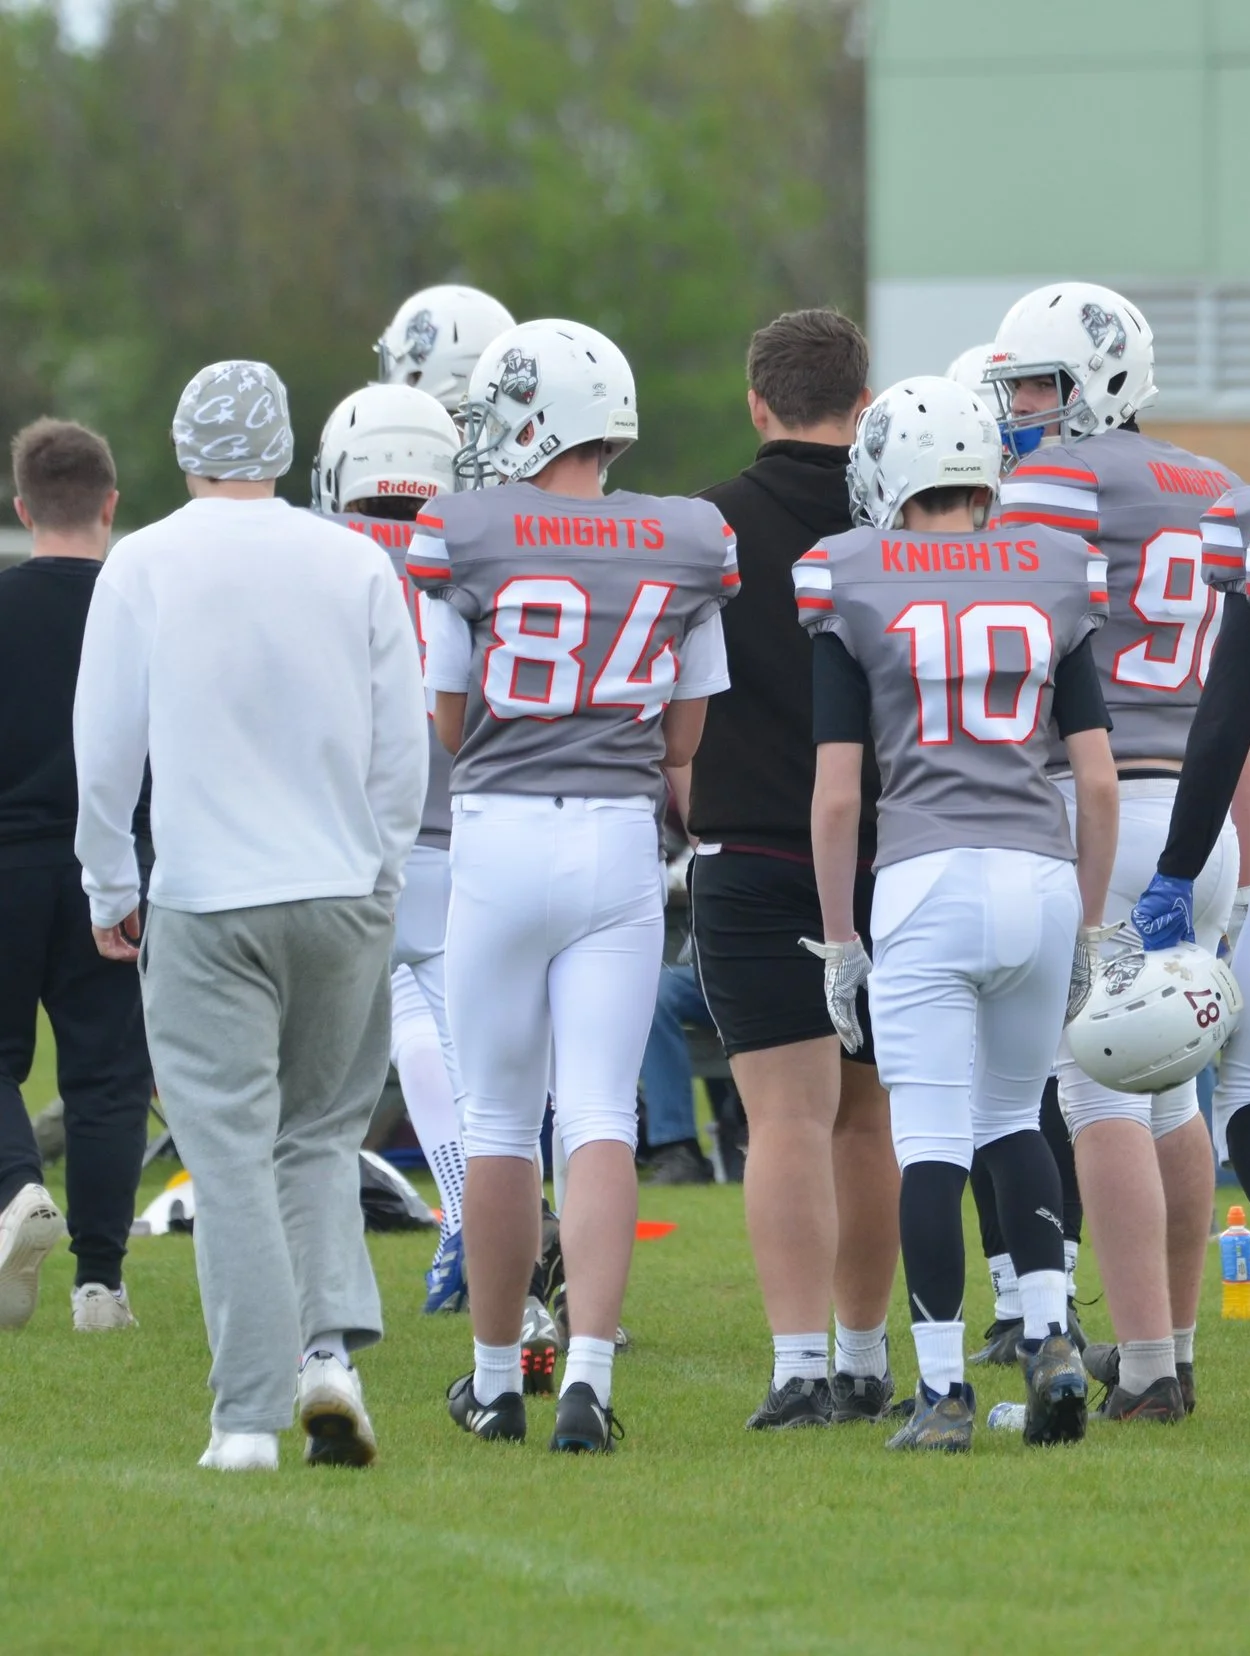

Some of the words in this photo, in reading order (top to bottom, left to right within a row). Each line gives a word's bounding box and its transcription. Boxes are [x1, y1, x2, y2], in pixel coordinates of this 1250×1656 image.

[377, 480, 437, 498] Riddell
[1147, 461, 1232, 499] KNIGHTS
[514, 514, 664, 550] KNIGHTS
[881, 539, 1040, 573] KNIGHTS
[483, 575, 681, 725] 84
[884, 600, 1055, 746] 10
[1183, 988, 1220, 1029] 87
